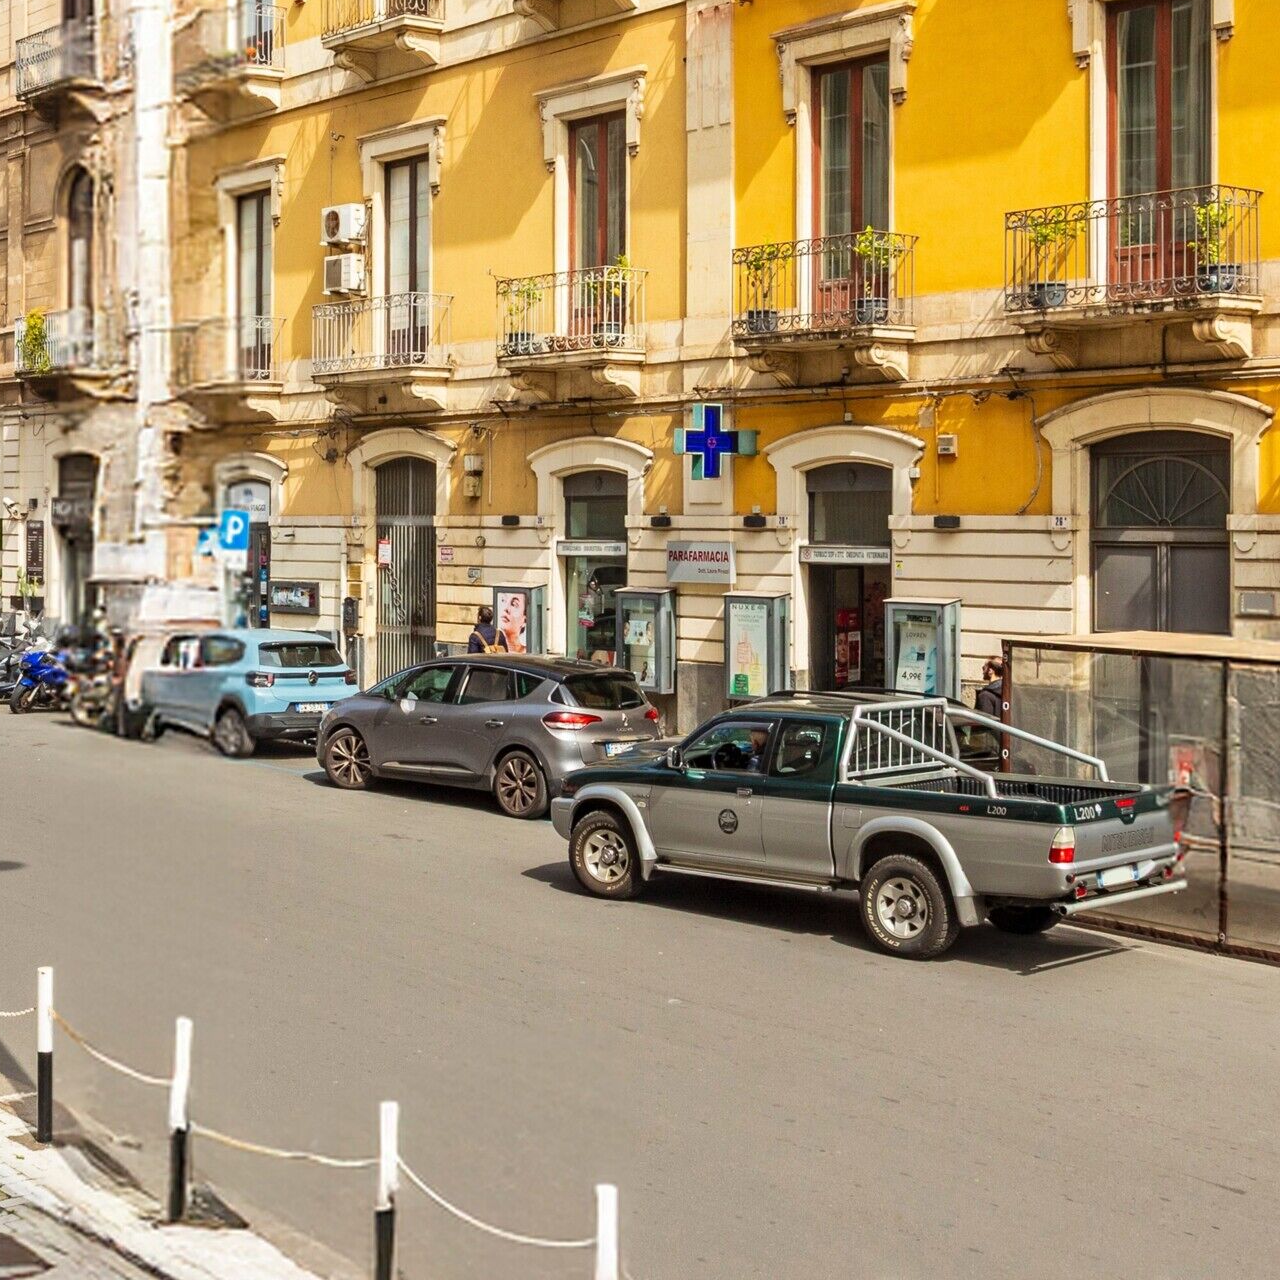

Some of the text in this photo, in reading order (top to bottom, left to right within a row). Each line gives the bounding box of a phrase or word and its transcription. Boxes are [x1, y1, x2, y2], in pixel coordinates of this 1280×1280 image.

[225, 515, 245, 545] P
[668, 550, 729, 563] PARAFARMACIA
[901, 671, 922, 681] 4,99€
[986, 805, 1007, 816] L200
[1074, 805, 1096, 821] L200
[1101, 826, 1155, 853] MITSUBISHI
